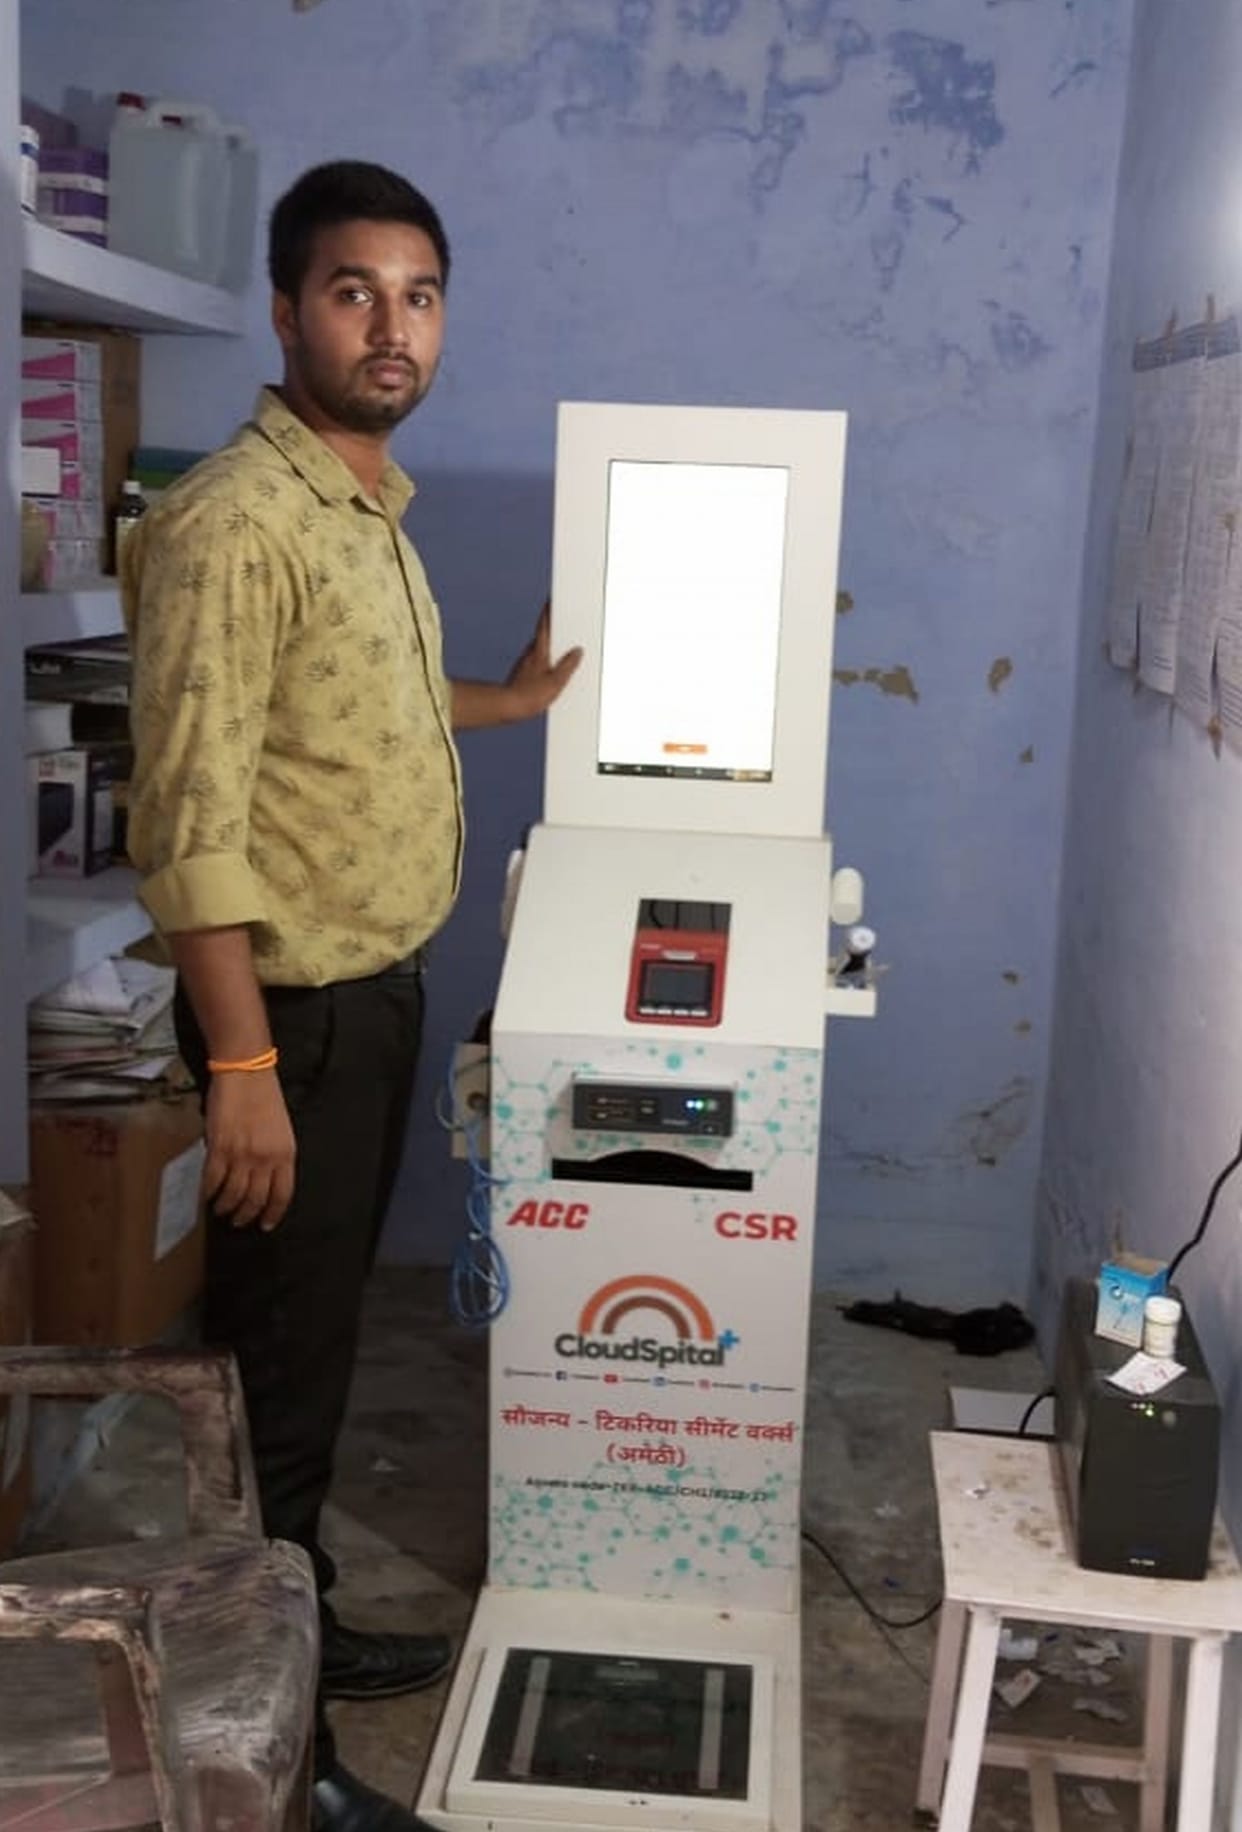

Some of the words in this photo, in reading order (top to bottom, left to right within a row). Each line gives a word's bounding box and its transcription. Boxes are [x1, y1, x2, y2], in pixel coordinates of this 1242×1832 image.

[507, 1199, 589, 1230] ACC
[715, 1212, 797, 1241] CSR
[555, 1333, 725, 1368] CloudSpital
[500, 1404, 570, 1428] सौजन्य
[595, 1410, 677, 1436] टिकरिया
[606, 1439, 686, 1468] (अमेठी)
